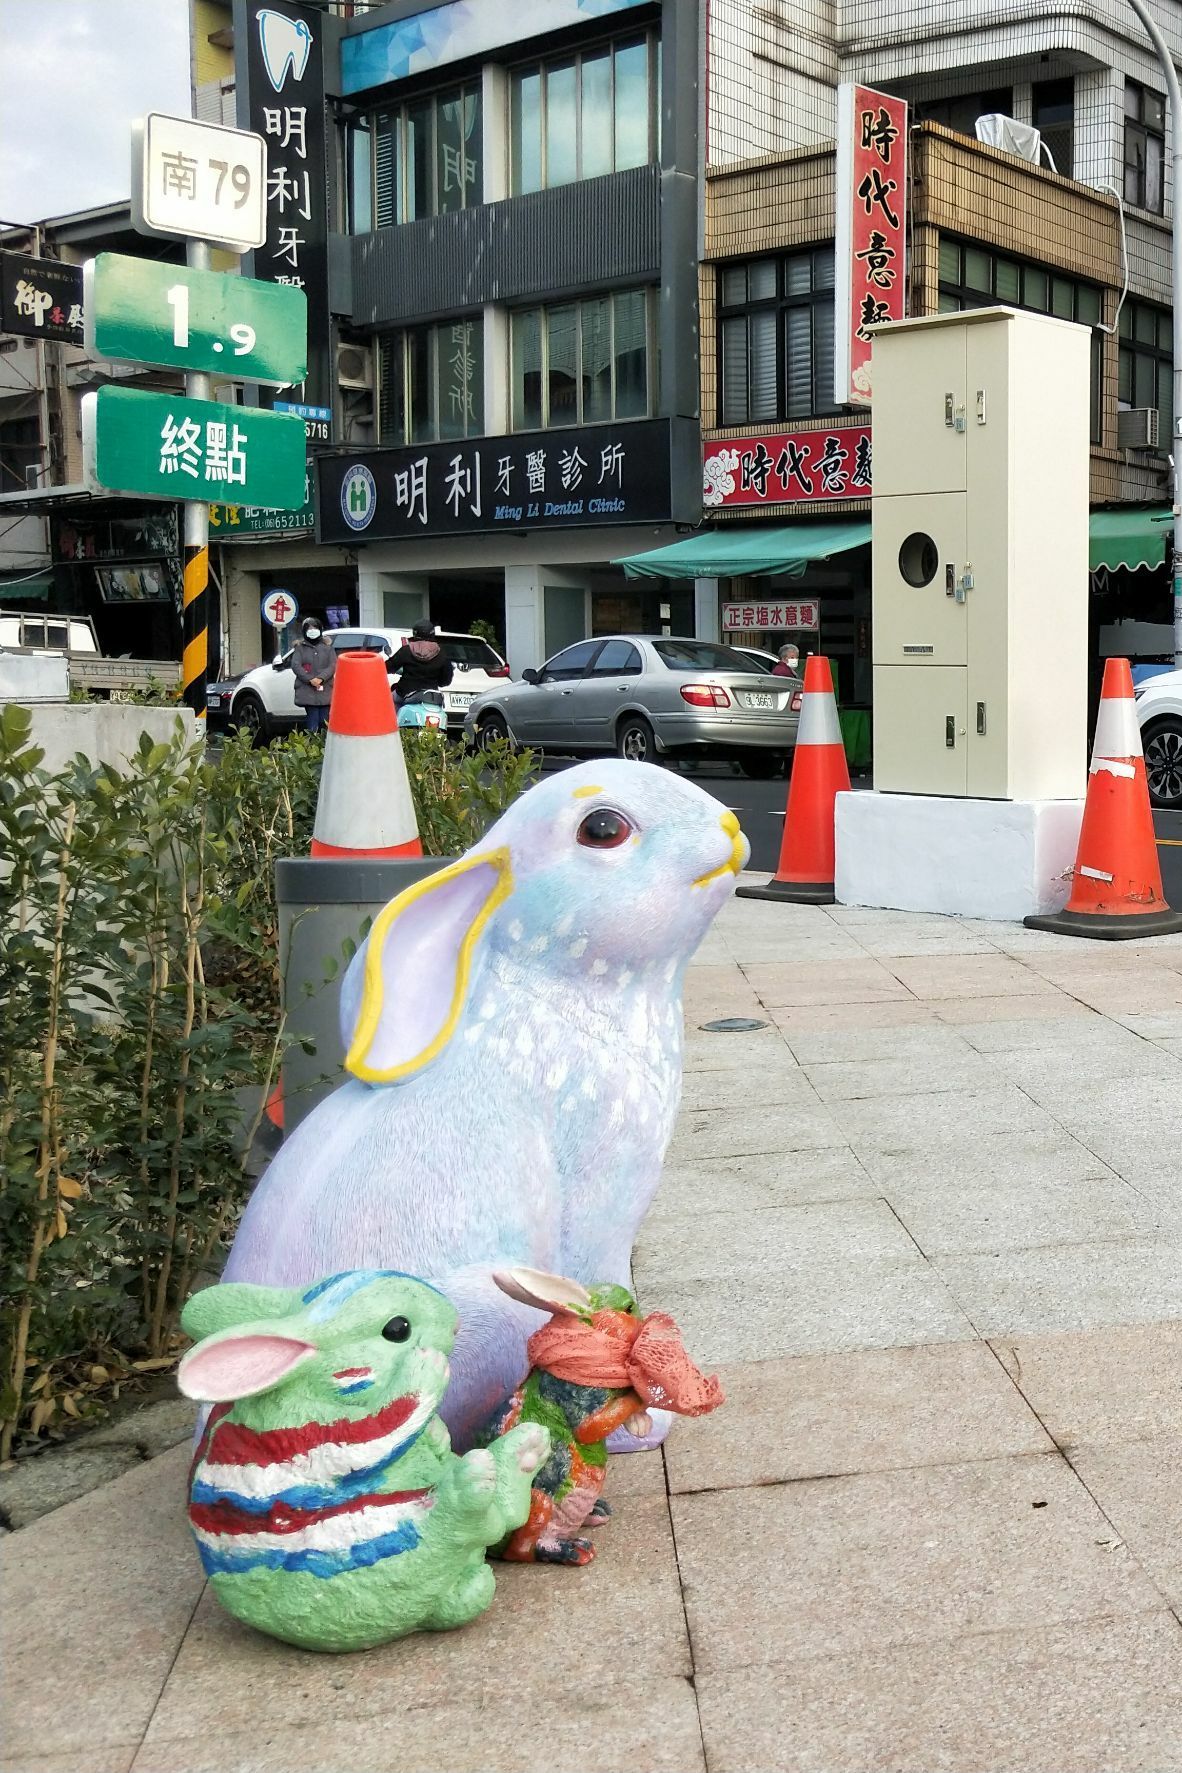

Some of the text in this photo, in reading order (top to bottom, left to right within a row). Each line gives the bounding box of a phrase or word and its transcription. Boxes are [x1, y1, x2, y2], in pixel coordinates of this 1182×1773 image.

[160, 151, 251, 210] 南79
[167, 284, 256, 356] 1.9
[158, 414, 249, 486] 終點
[394, 442, 626, 525] 明利牙醫診所
[494, 504, 523, 520] Ming
[543, 499, 584, 516] Dental
[588, 497, 626, 513] Clinic
